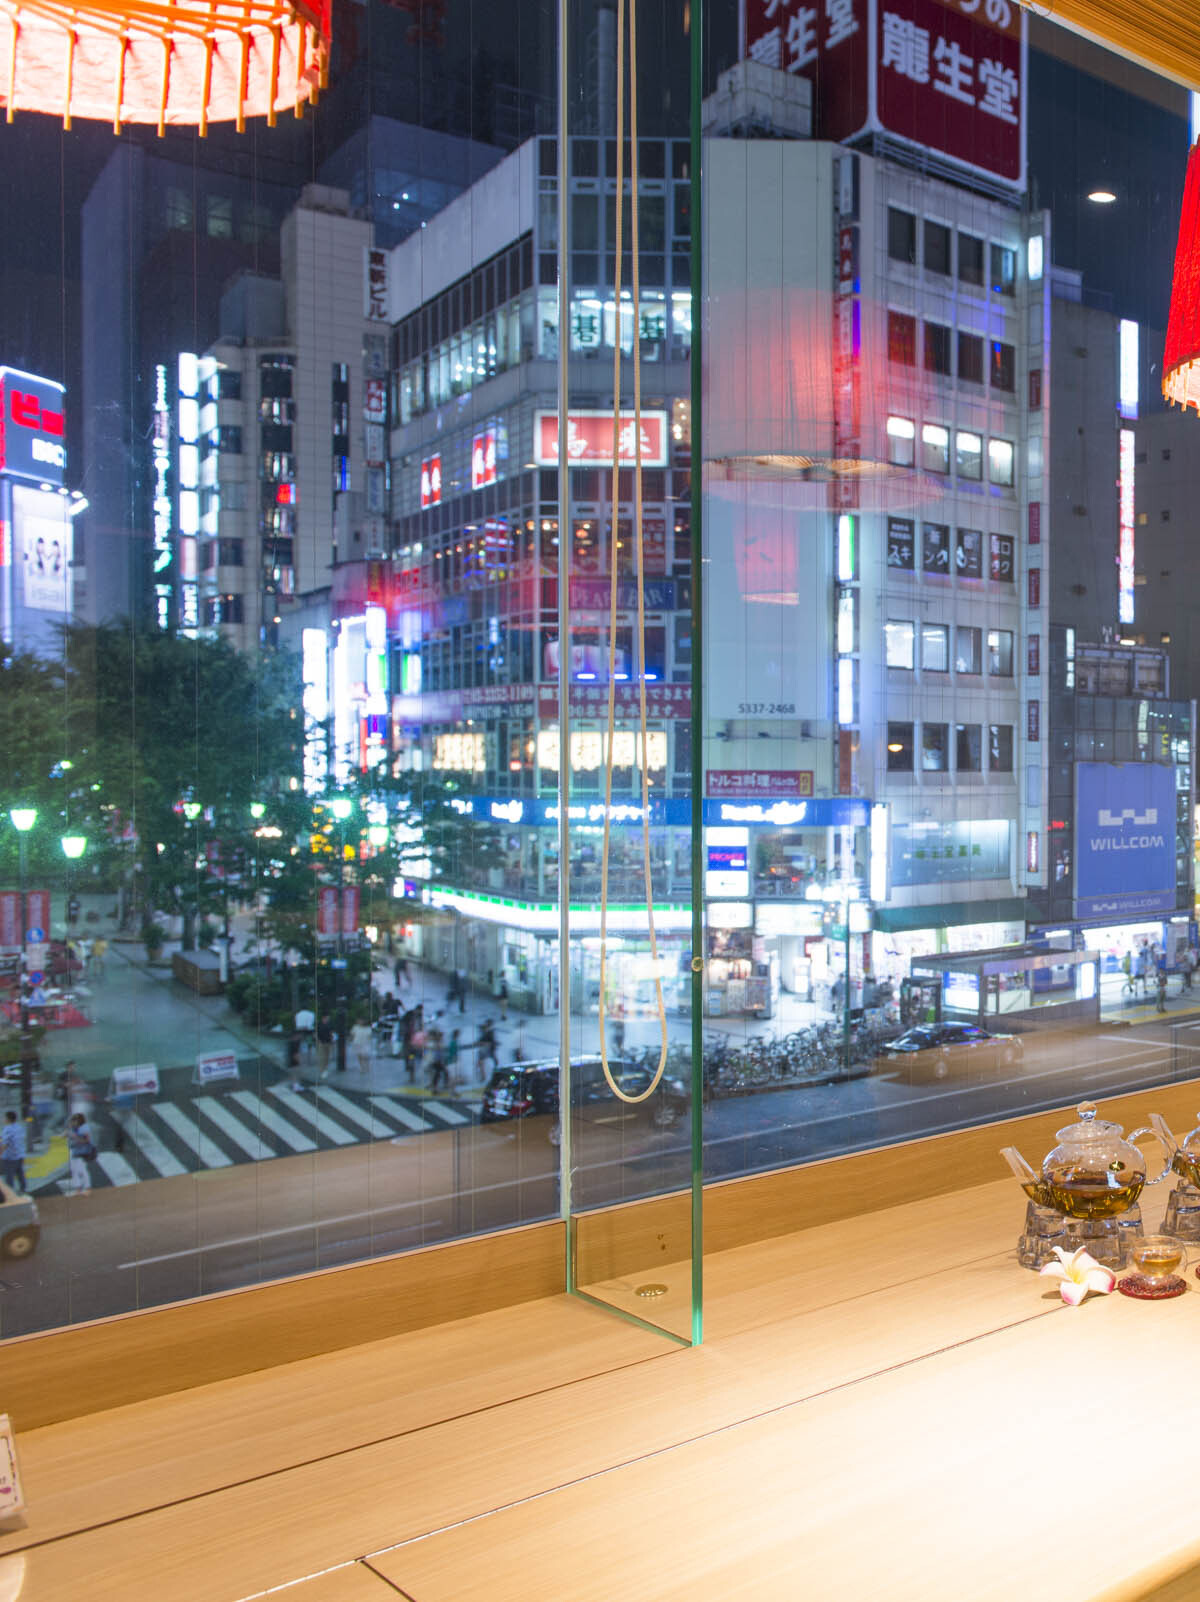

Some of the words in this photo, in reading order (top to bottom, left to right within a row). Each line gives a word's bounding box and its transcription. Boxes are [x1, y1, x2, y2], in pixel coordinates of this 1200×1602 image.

[882, 11, 1018, 125] 龍生堂
[1090, 835, 1164, 851] WILLCOM
